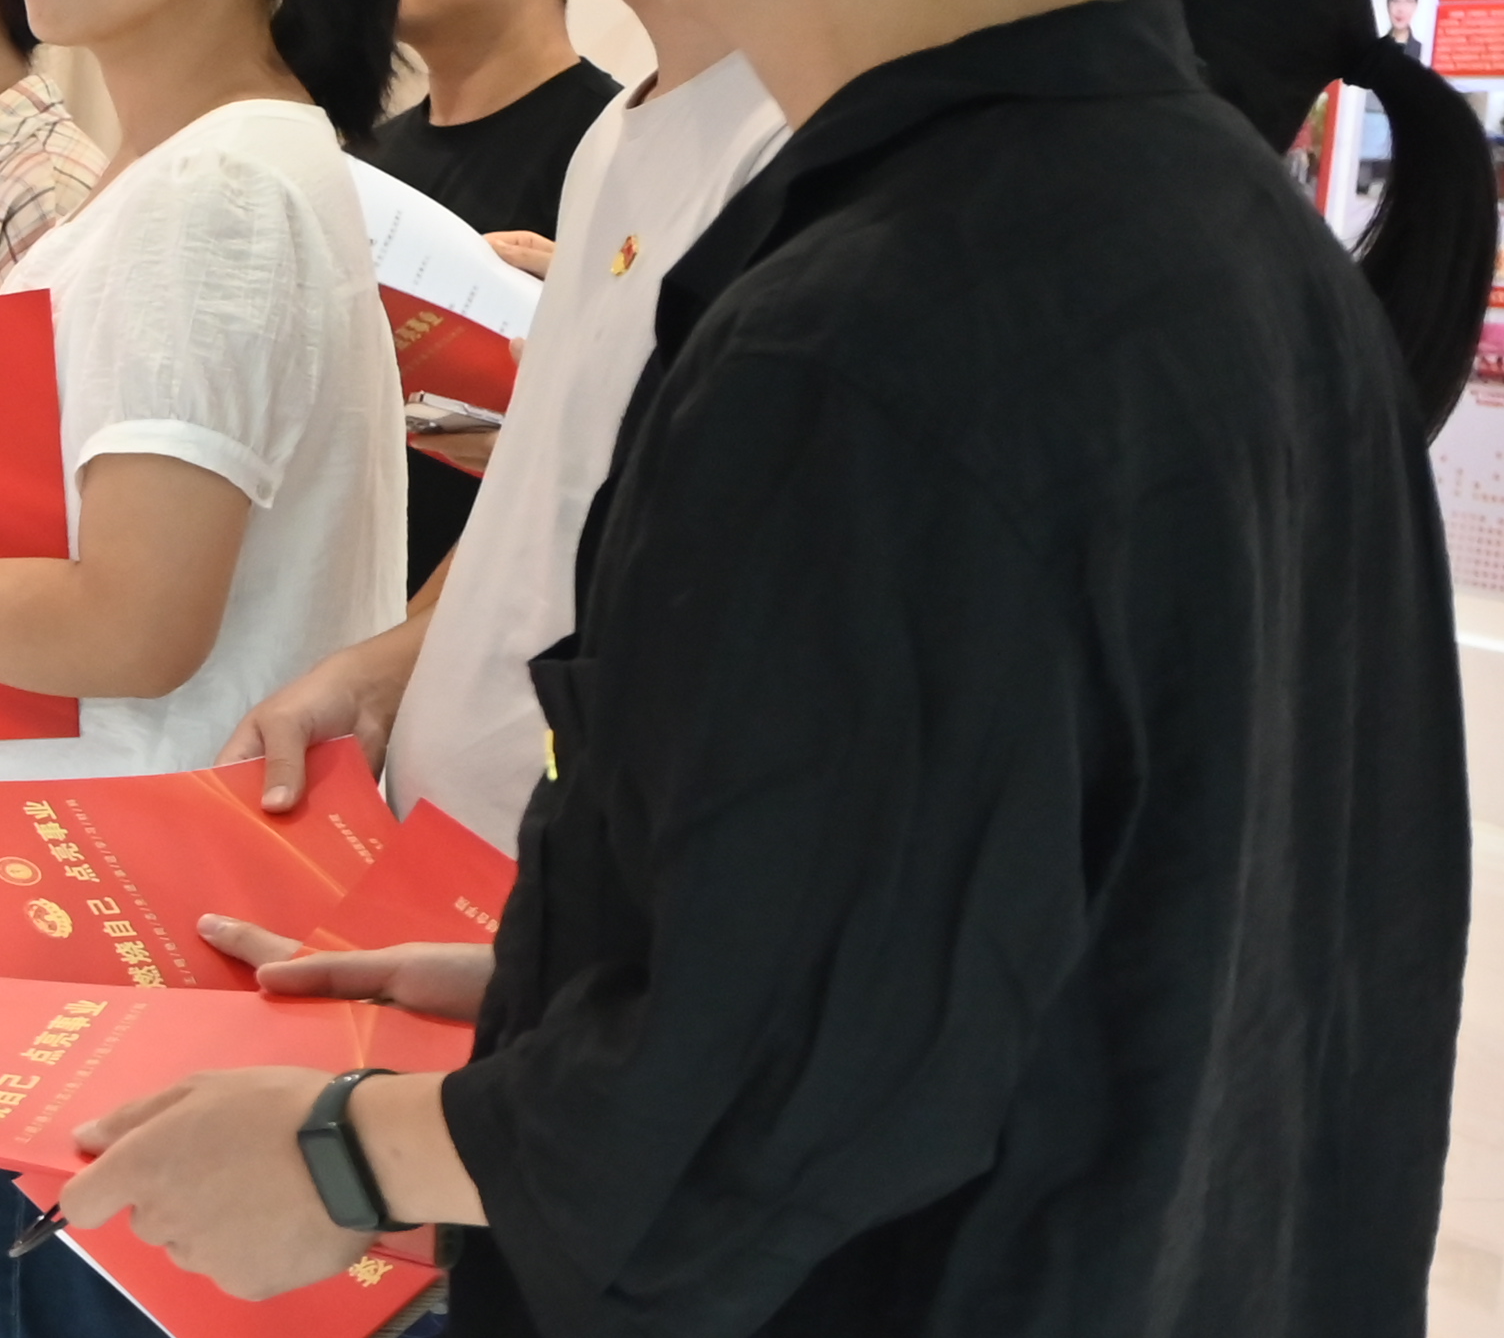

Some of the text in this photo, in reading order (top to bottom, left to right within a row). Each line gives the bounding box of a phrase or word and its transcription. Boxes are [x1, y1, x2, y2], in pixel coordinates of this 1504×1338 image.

[22, 799, 168, 989] 燃烧自己 点亮事业
[19, 999, 109, 1066] 点亮事业
